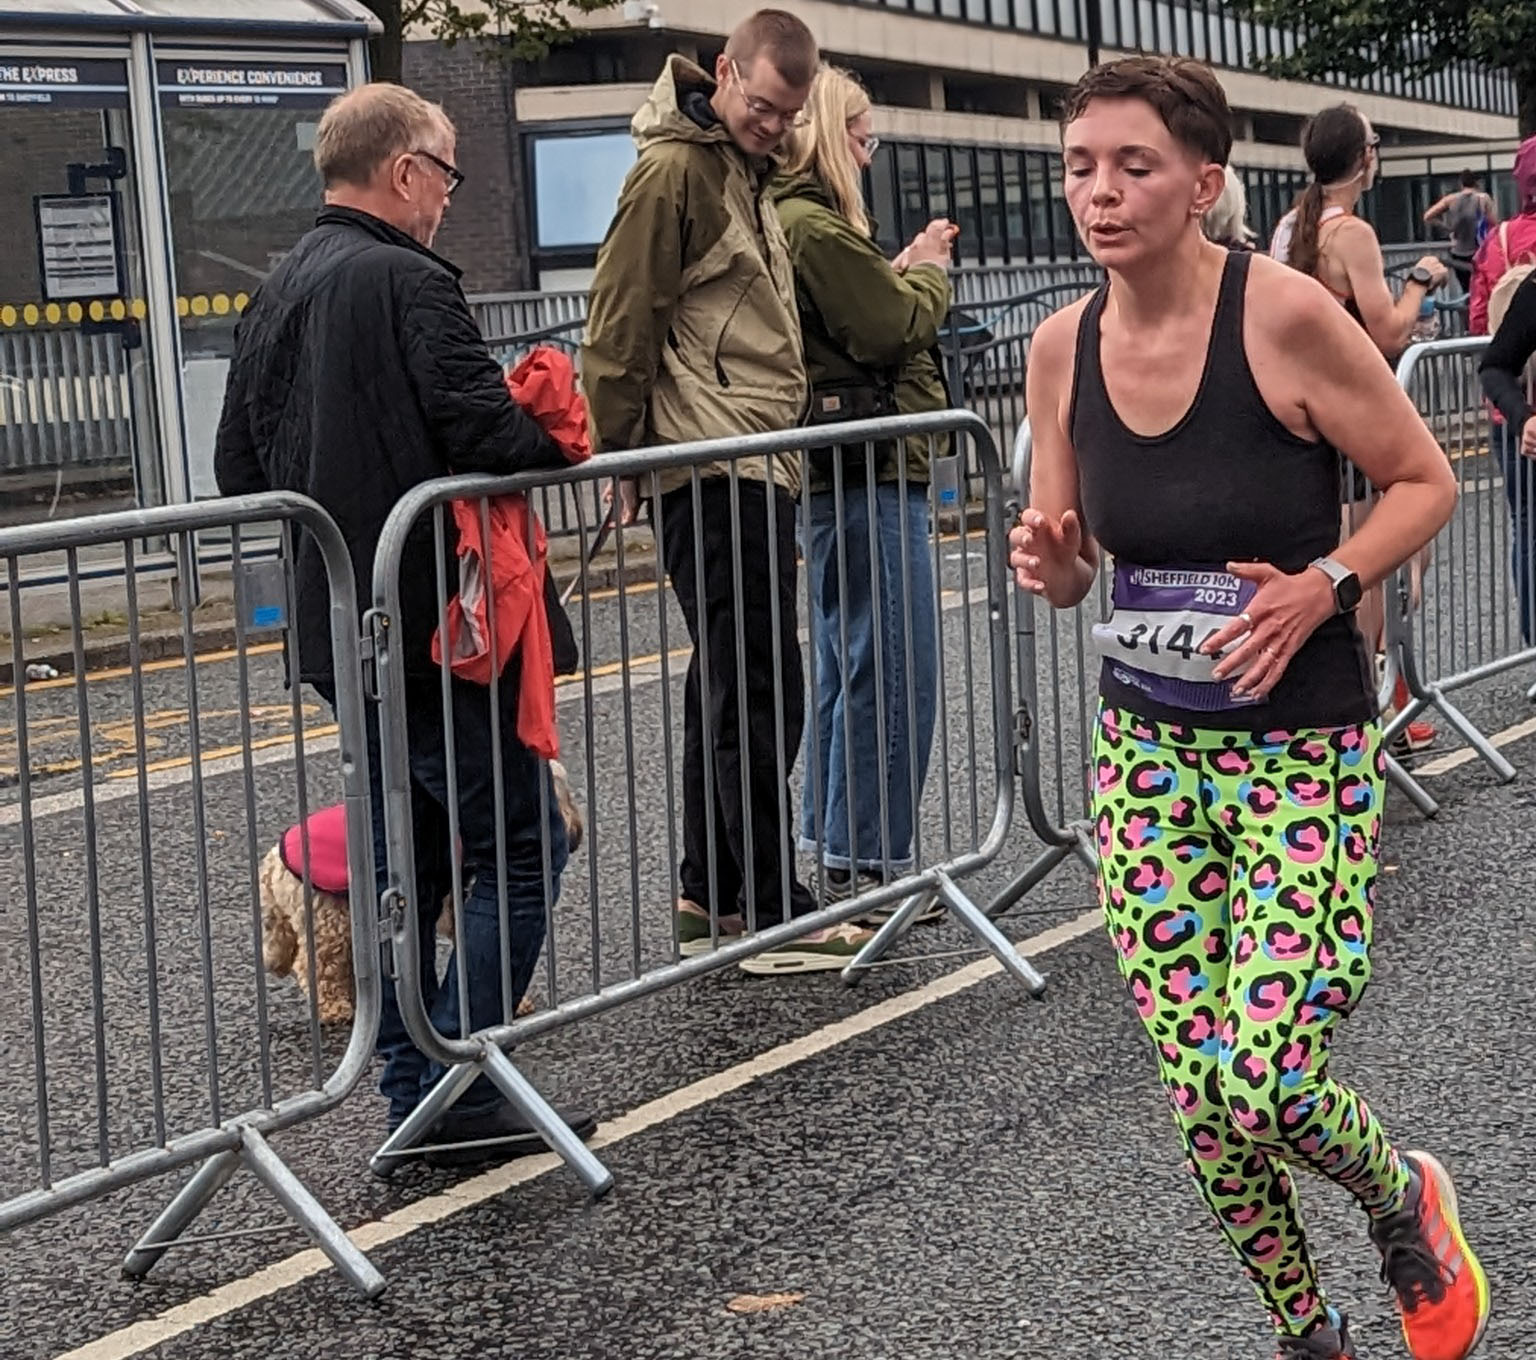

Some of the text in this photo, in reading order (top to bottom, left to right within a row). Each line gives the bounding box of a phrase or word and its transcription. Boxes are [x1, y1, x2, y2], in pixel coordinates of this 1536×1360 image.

[22, 65, 78, 83] EXPRESS
[177, 66, 323, 86] EXPERIENCE CONVENIENCE
[1144, 570, 1238, 589] SHEFFIELD 10K
[1194, 588, 1238, 607] 2023
